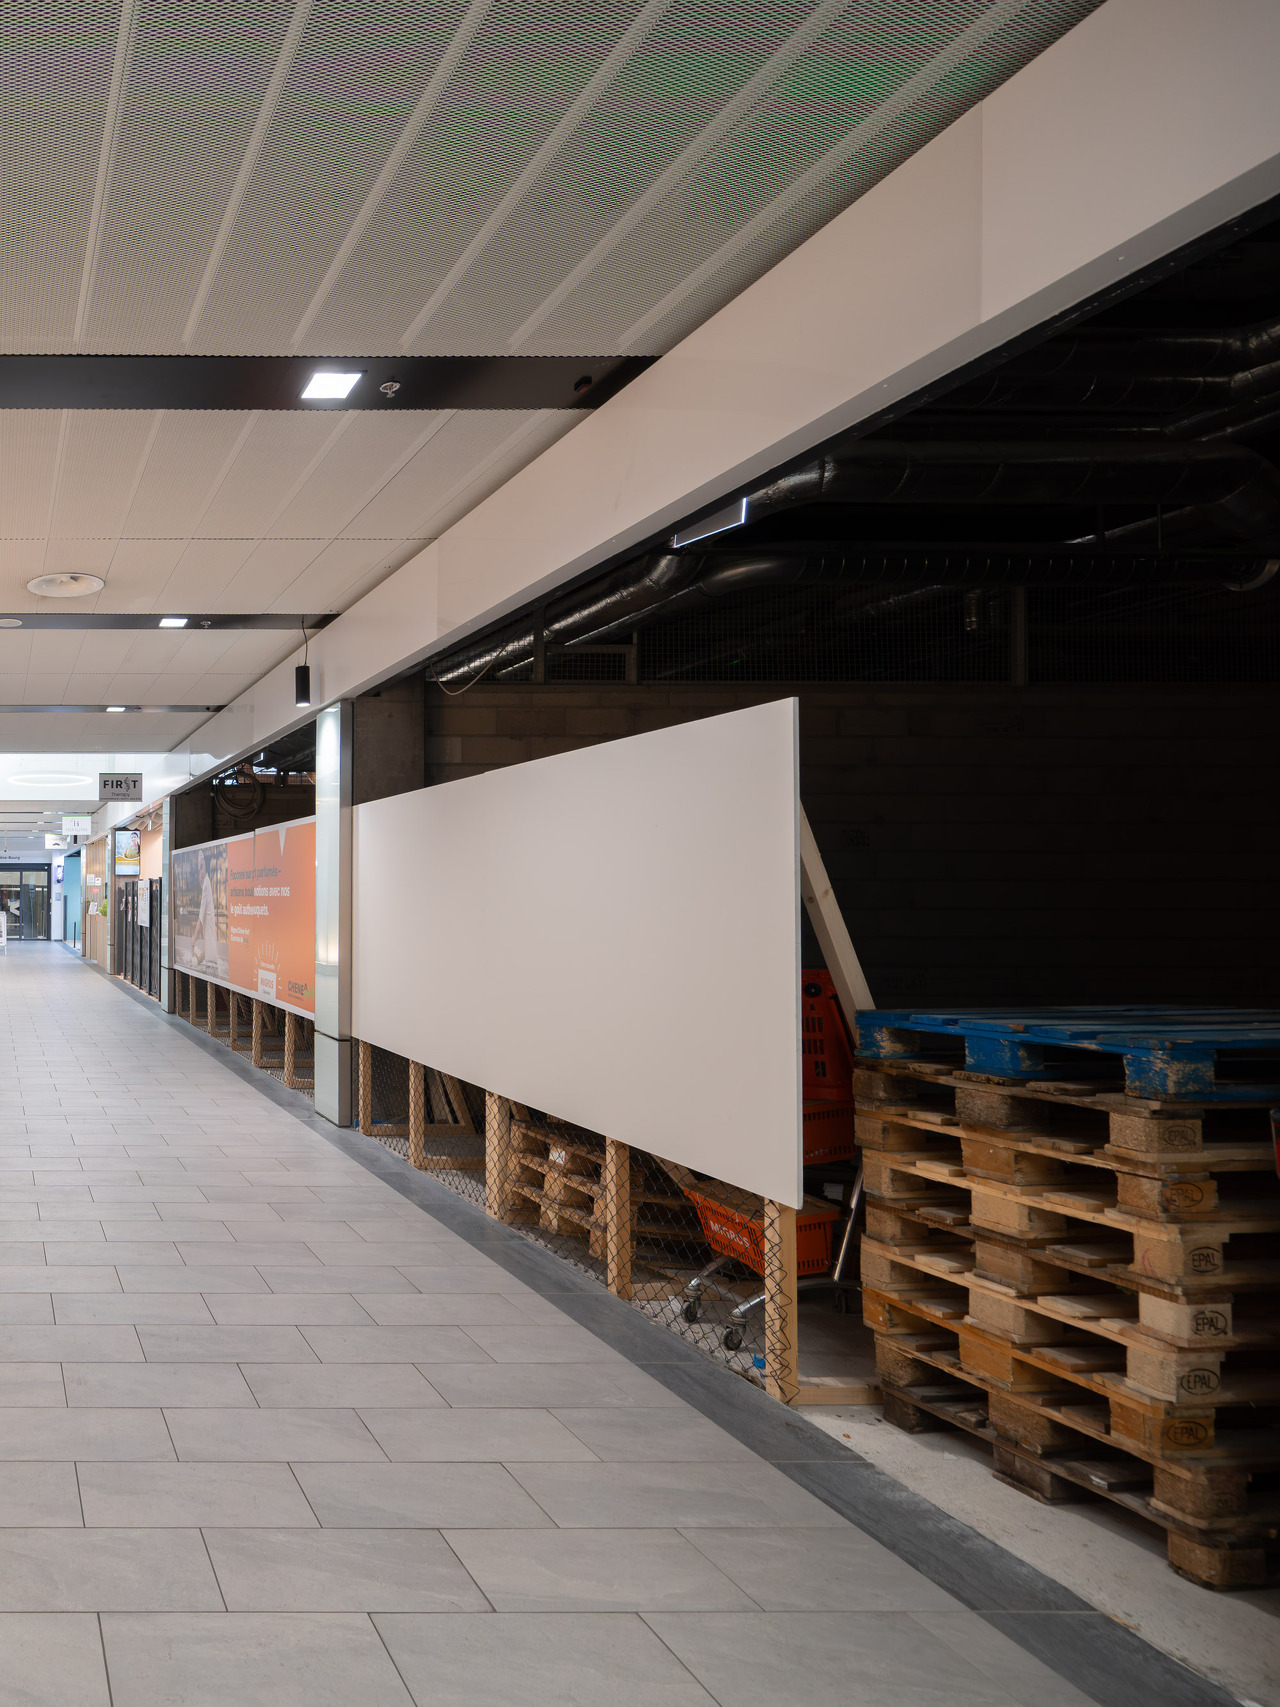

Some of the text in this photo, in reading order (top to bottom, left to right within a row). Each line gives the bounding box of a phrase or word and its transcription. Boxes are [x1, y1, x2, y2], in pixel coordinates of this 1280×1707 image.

[709, 1219, 750, 1249] MIGROS
[1191, 1252, 1220, 1268] EPAL
[1195, 1317, 1223, 1332] EPAL
[1185, 1374, 1216, 1390] EPAL
